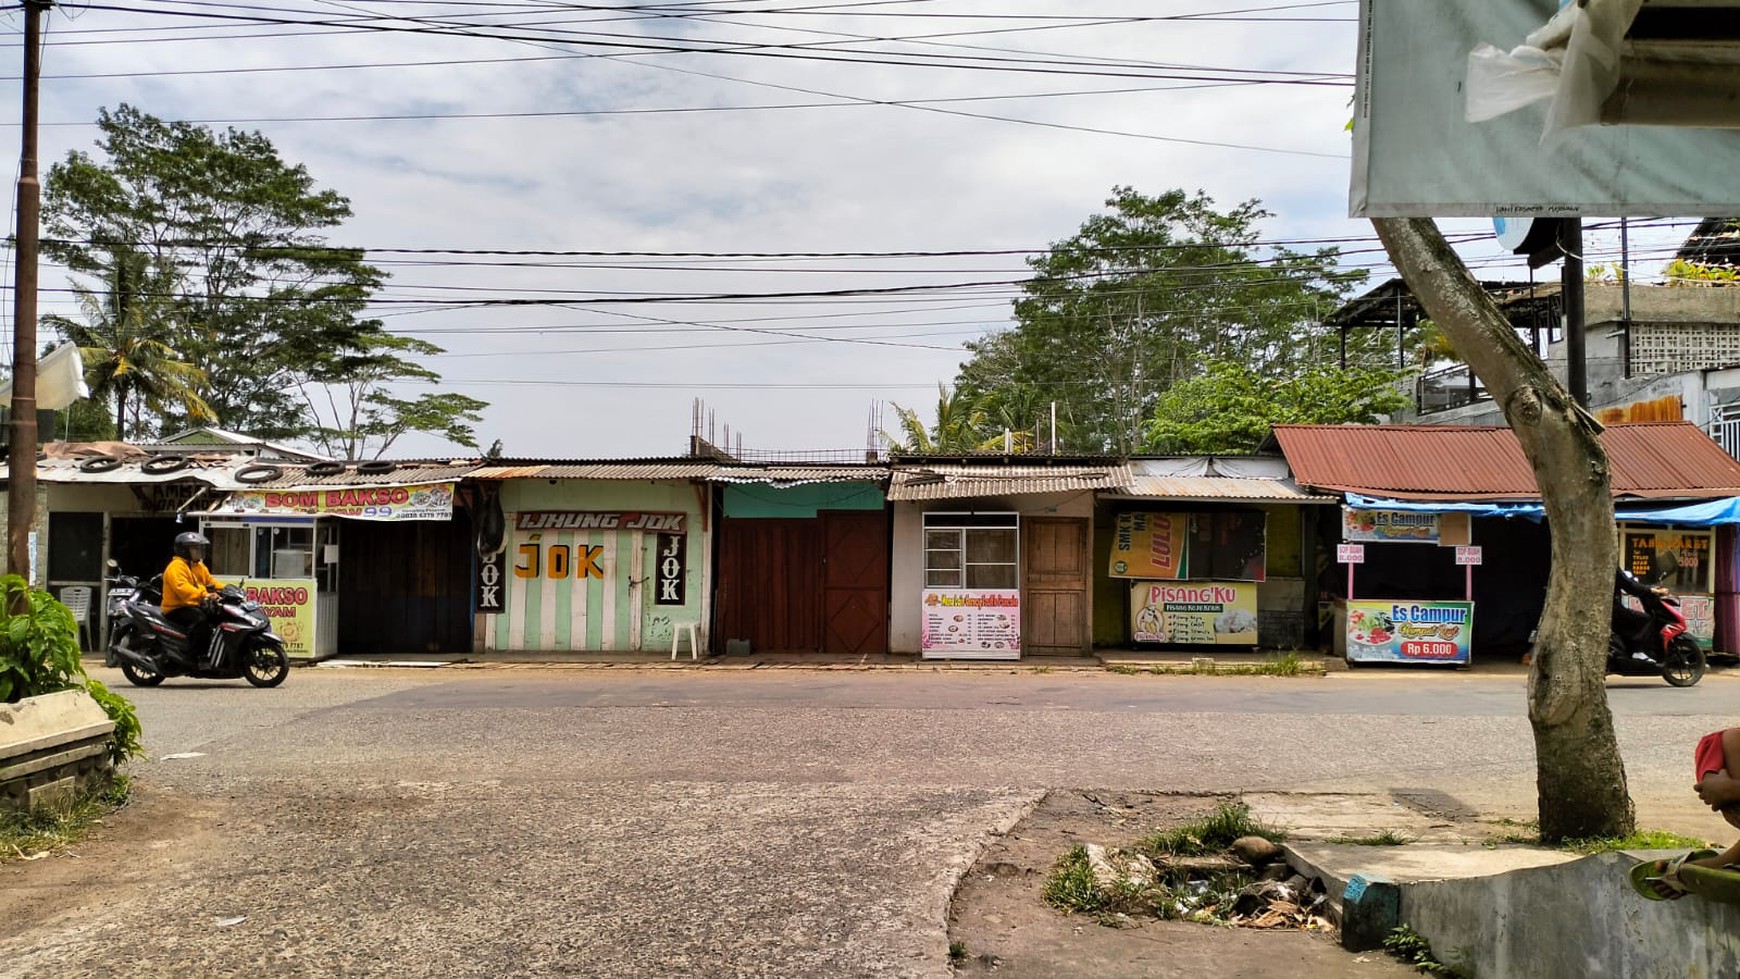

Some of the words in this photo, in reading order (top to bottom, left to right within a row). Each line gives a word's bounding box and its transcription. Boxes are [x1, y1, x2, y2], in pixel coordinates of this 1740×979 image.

[265, 492, 319, 507] BOM
[326, 487, 409, 506] BAKSO
[364, 506, 393, 517] 99
[1376, 511, 1389, 524] Es
[1391, 511, 1435, 526] Campur
[626, 514, 683, 530] JOK
[1119, 526, 1131, 551] SMK
[661, 536, 681, 600] JOK
[247, 587, 308, 605] BAKSO
[1392, 605, 1407, 621] Es
[1410, 605, 1466, 623] Campur
[1407, 643, 1421, 655] Rp
[1422, 644, 1452, 655] 6.000
